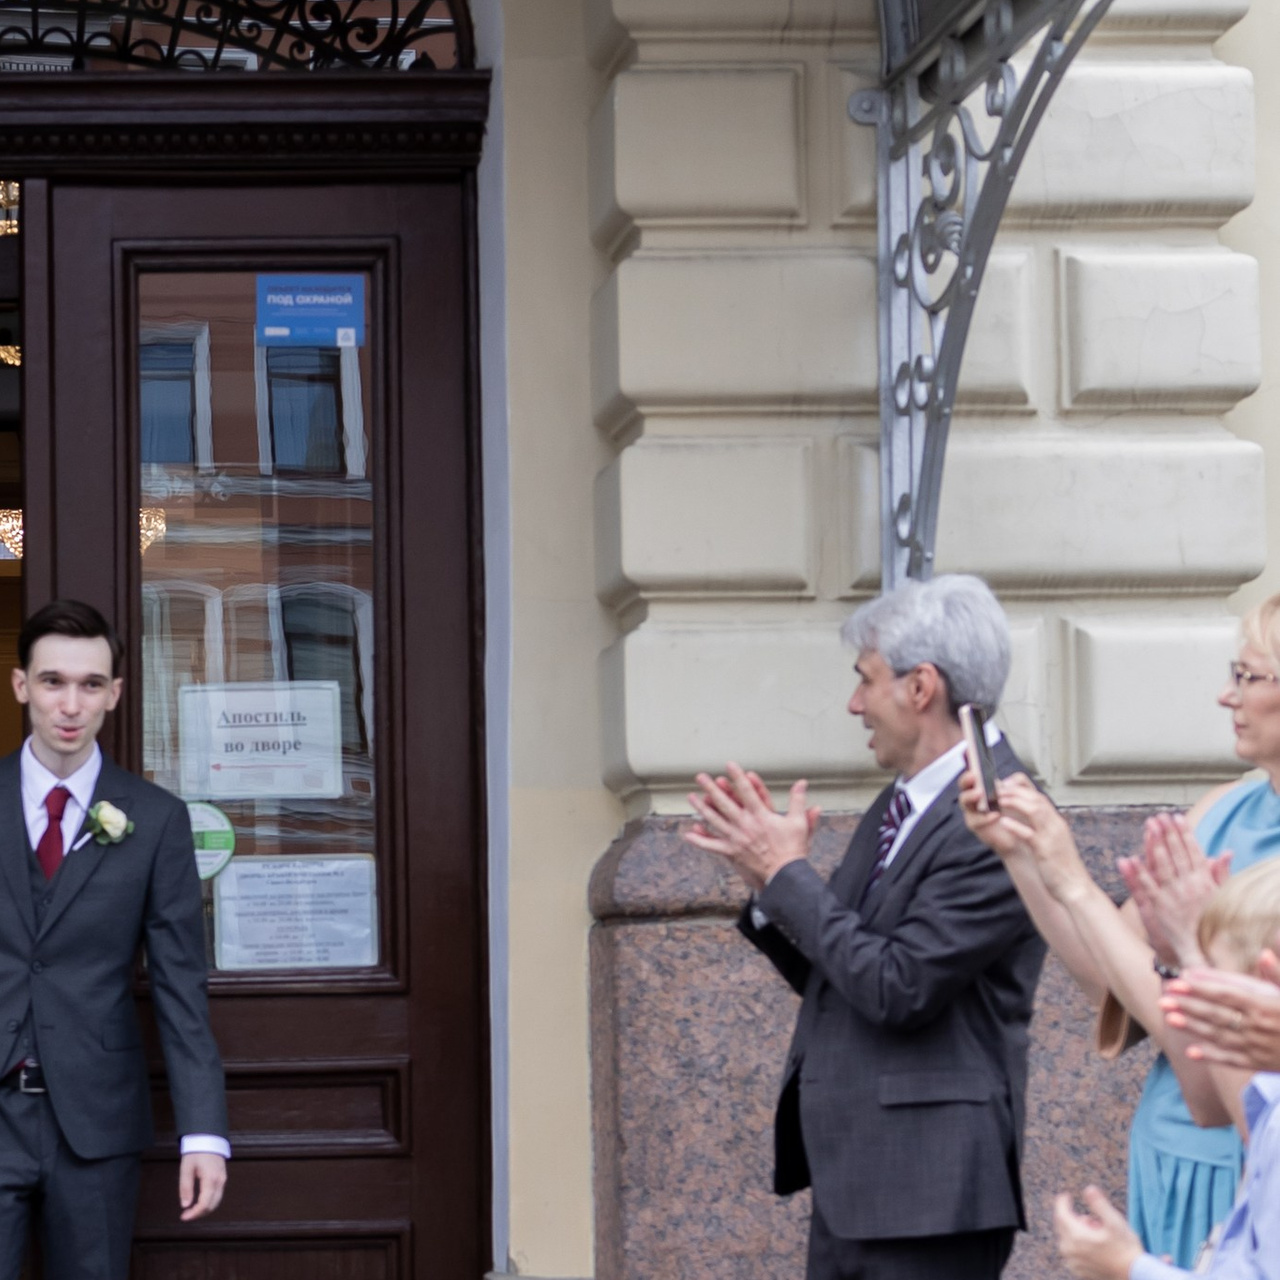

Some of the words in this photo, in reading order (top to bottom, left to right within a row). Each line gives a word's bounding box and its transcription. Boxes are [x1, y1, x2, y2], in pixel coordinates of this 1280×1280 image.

[267, 294, 294, 306] ПОД
[296, 292, 353, 305] ОХРАНОЙ
[217, 710, 307, 725] Апостиль
[224, 740, 245, 753] во
[249, 739, 302, 755] дворе
